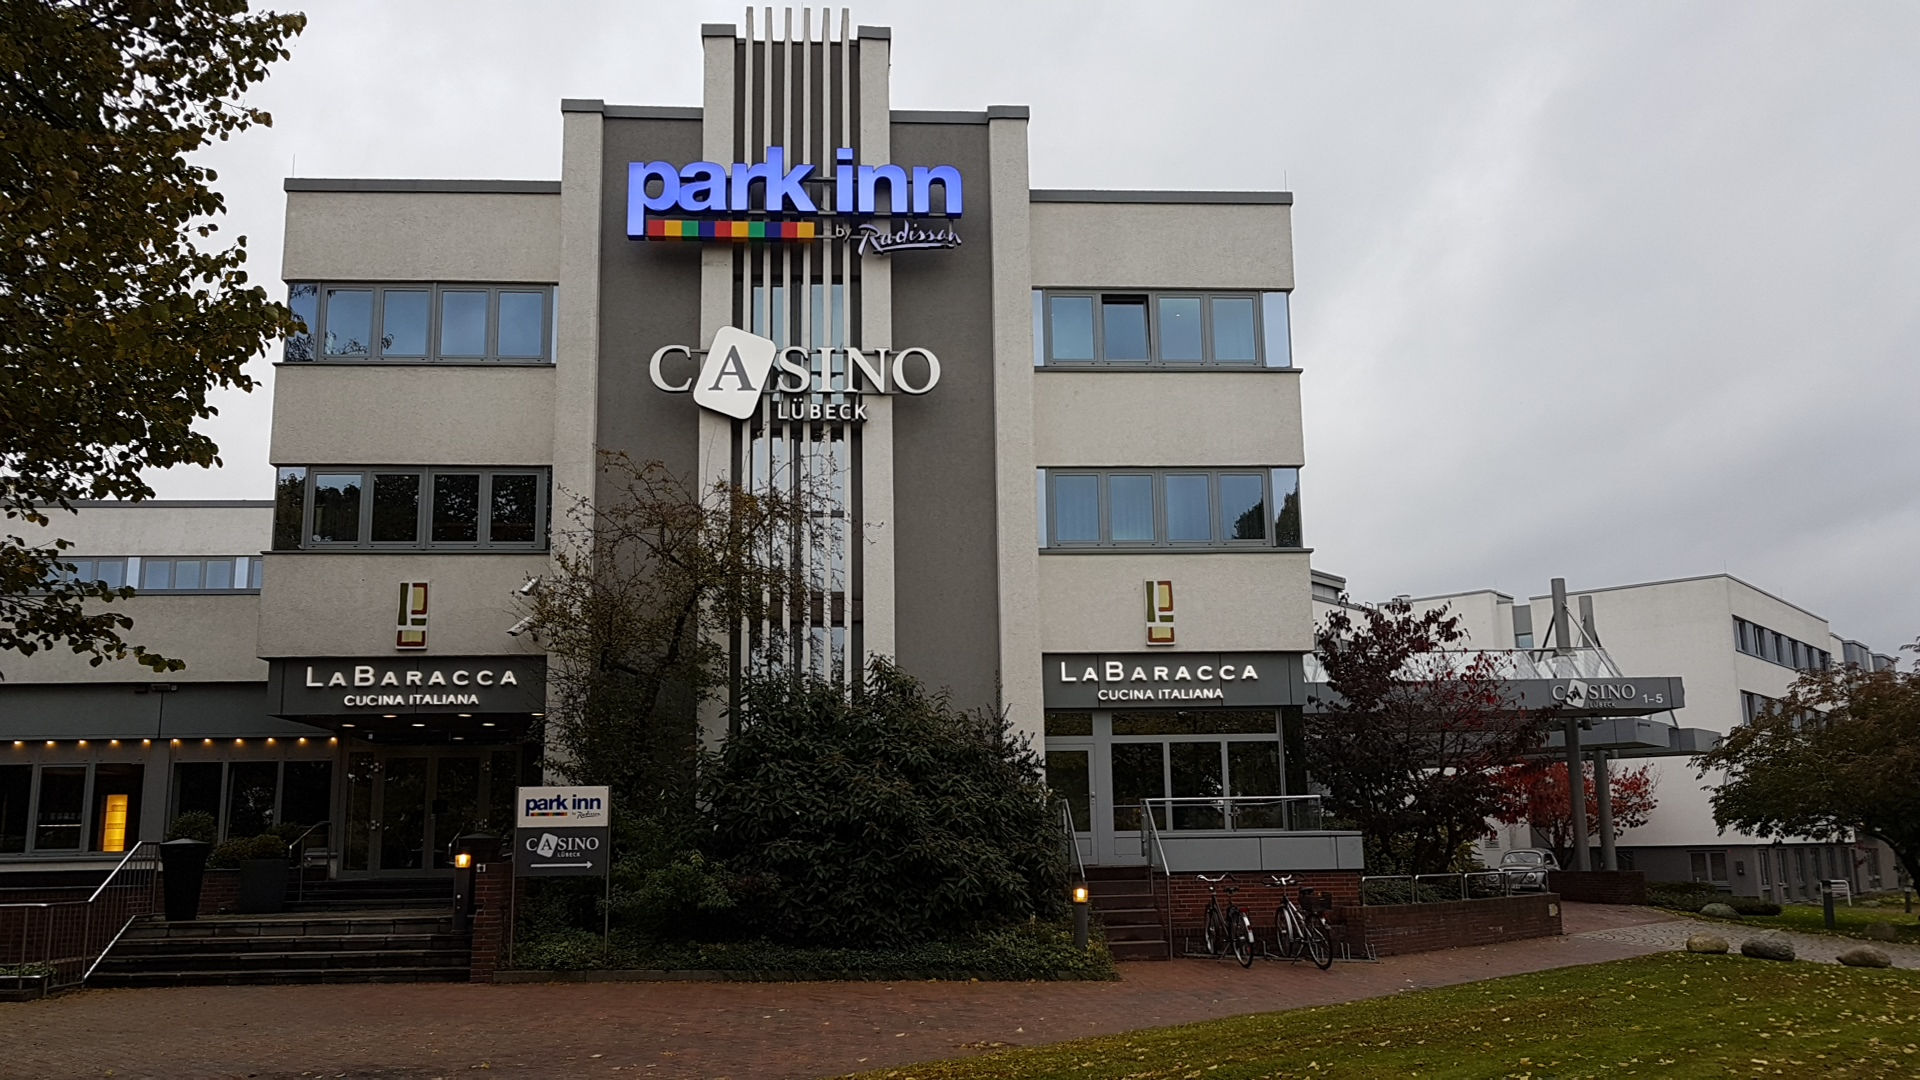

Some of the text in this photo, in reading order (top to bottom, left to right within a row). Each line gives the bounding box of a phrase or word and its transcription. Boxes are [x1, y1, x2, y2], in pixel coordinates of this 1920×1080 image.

[627, 146, 963, 240] park inn
[835, 220, 962, 256] by Radisson
[649, 344, 941, 395] CASINO
[777, 398, 868, 420] LÜBECK
[343, 694, 479, 706] CUCINA ITALIANA
[1097, 688, 1224, 701] CUCINA ITALIANA
[1552, 683, 1636, 700] CASINO
[1642, 693, 1664, 703] 1-5
[525, 794, 601, 816] park inn
[526, 837, 599, 851] CASINO
